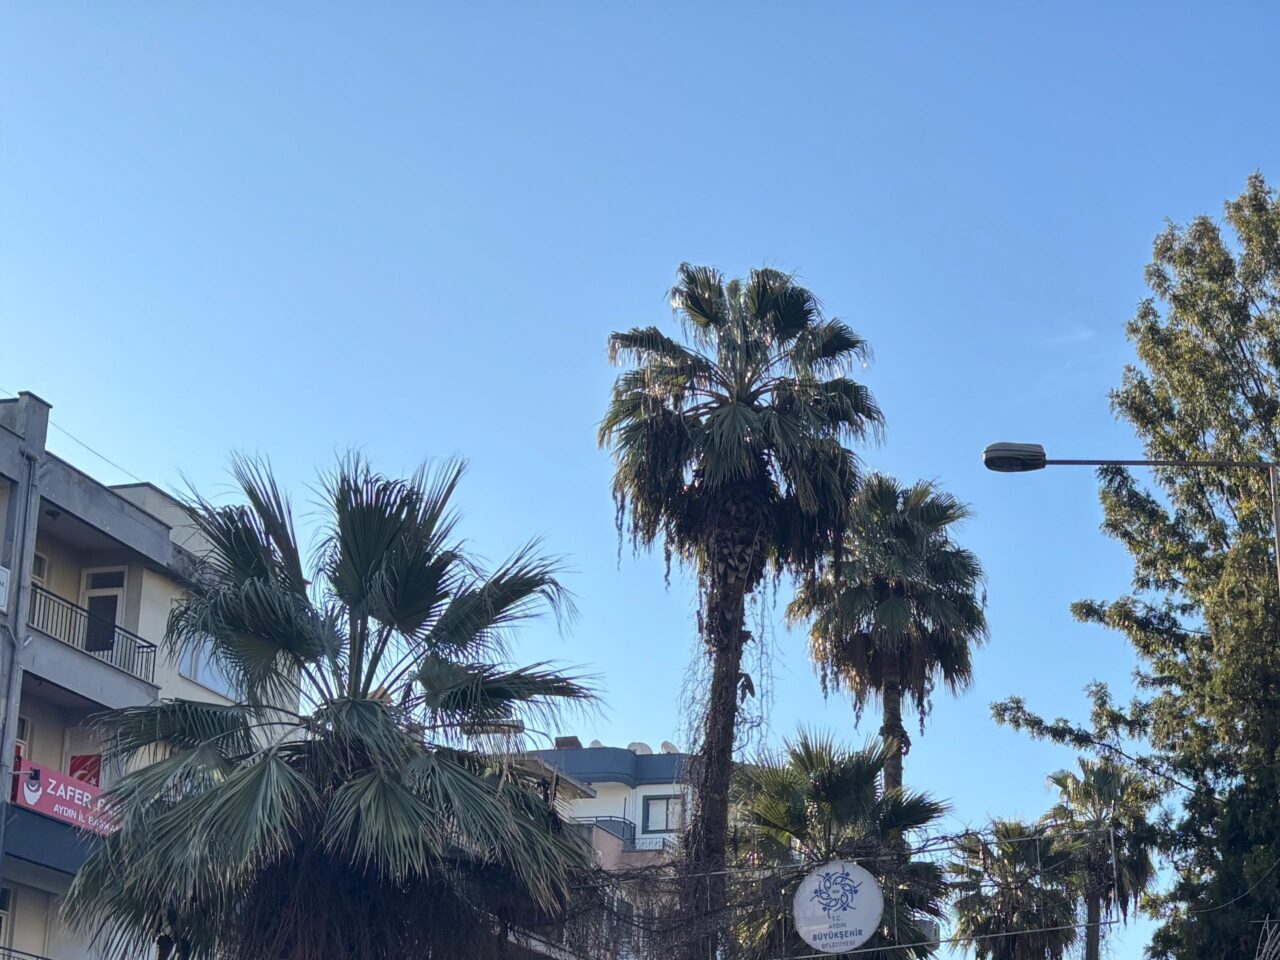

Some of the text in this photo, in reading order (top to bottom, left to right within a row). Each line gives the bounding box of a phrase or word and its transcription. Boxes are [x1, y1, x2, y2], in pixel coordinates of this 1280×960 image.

[46, 778, 92, 808] ZAFER
[53, 803, 76, 819] AYDIN
[78, 809, 86, 823] İL
[812, 928, 863, 941] BÜYÜKŞEHİR
